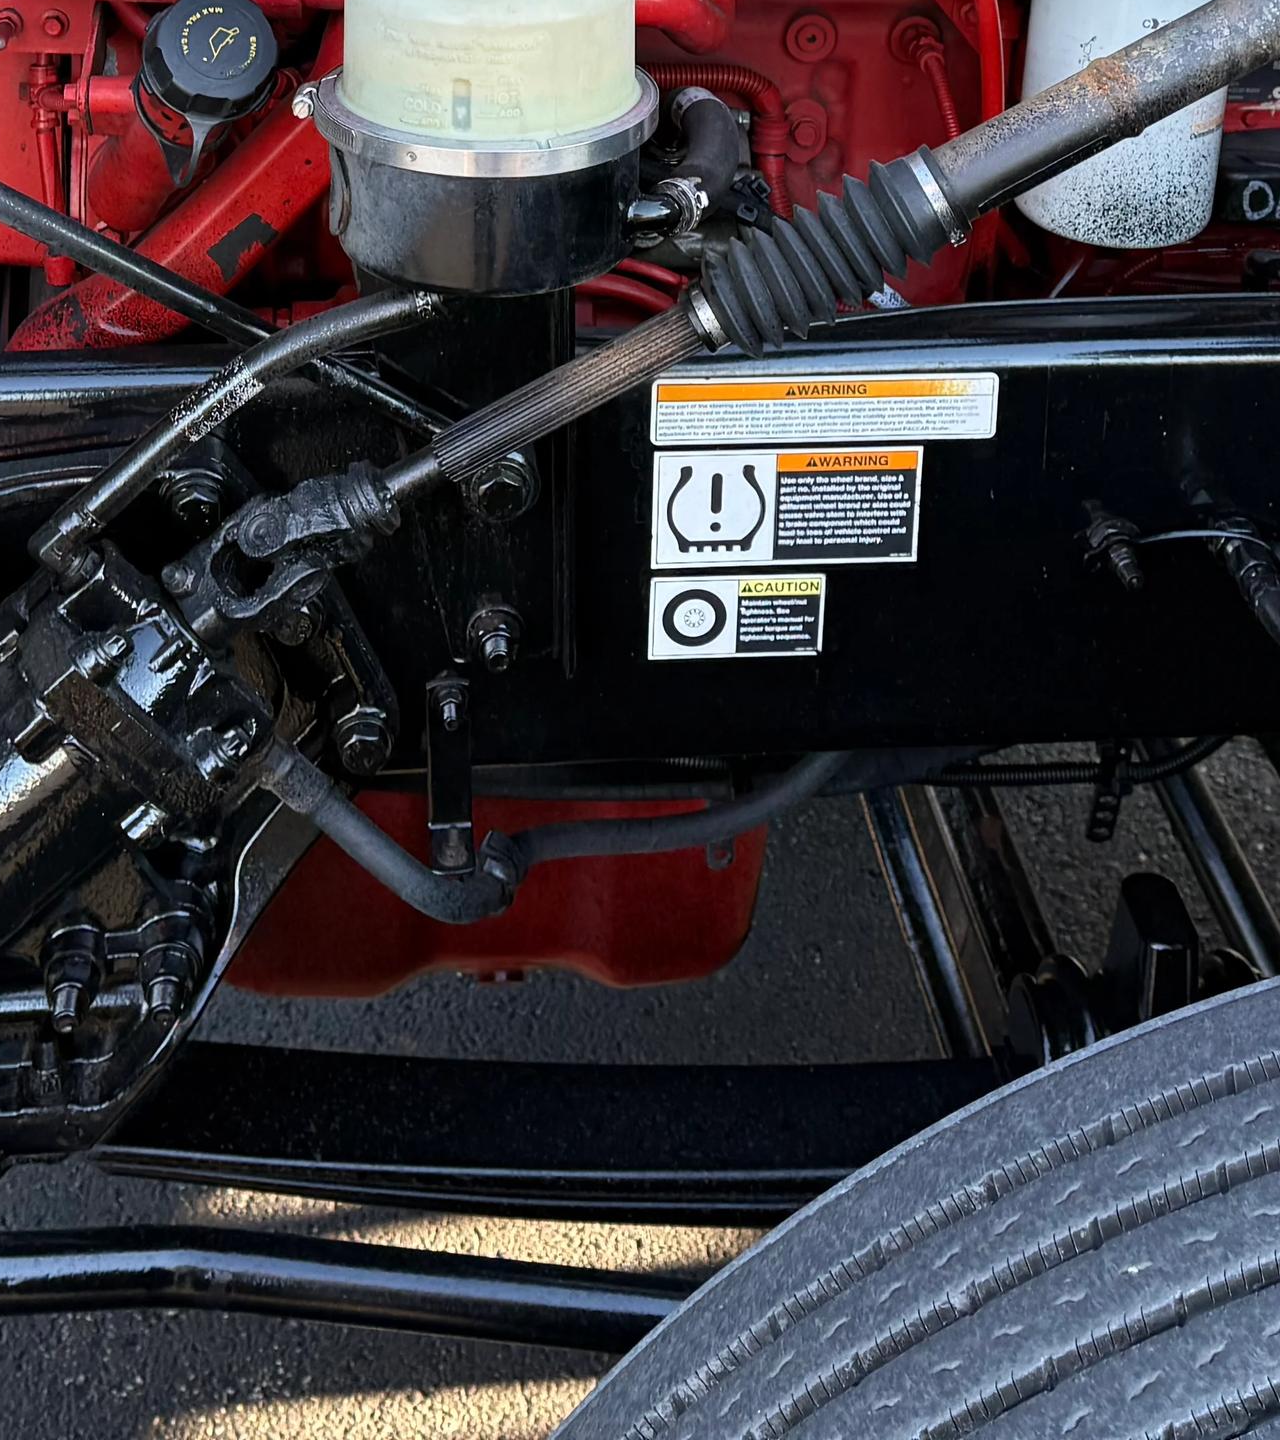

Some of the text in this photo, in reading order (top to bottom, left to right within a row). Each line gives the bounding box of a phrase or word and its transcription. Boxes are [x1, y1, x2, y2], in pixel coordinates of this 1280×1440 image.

[797, 384, 867, 396] WARNING
[818, 455, 889, 467] WARNING
[754, 581, 819, 593] CAUTION
